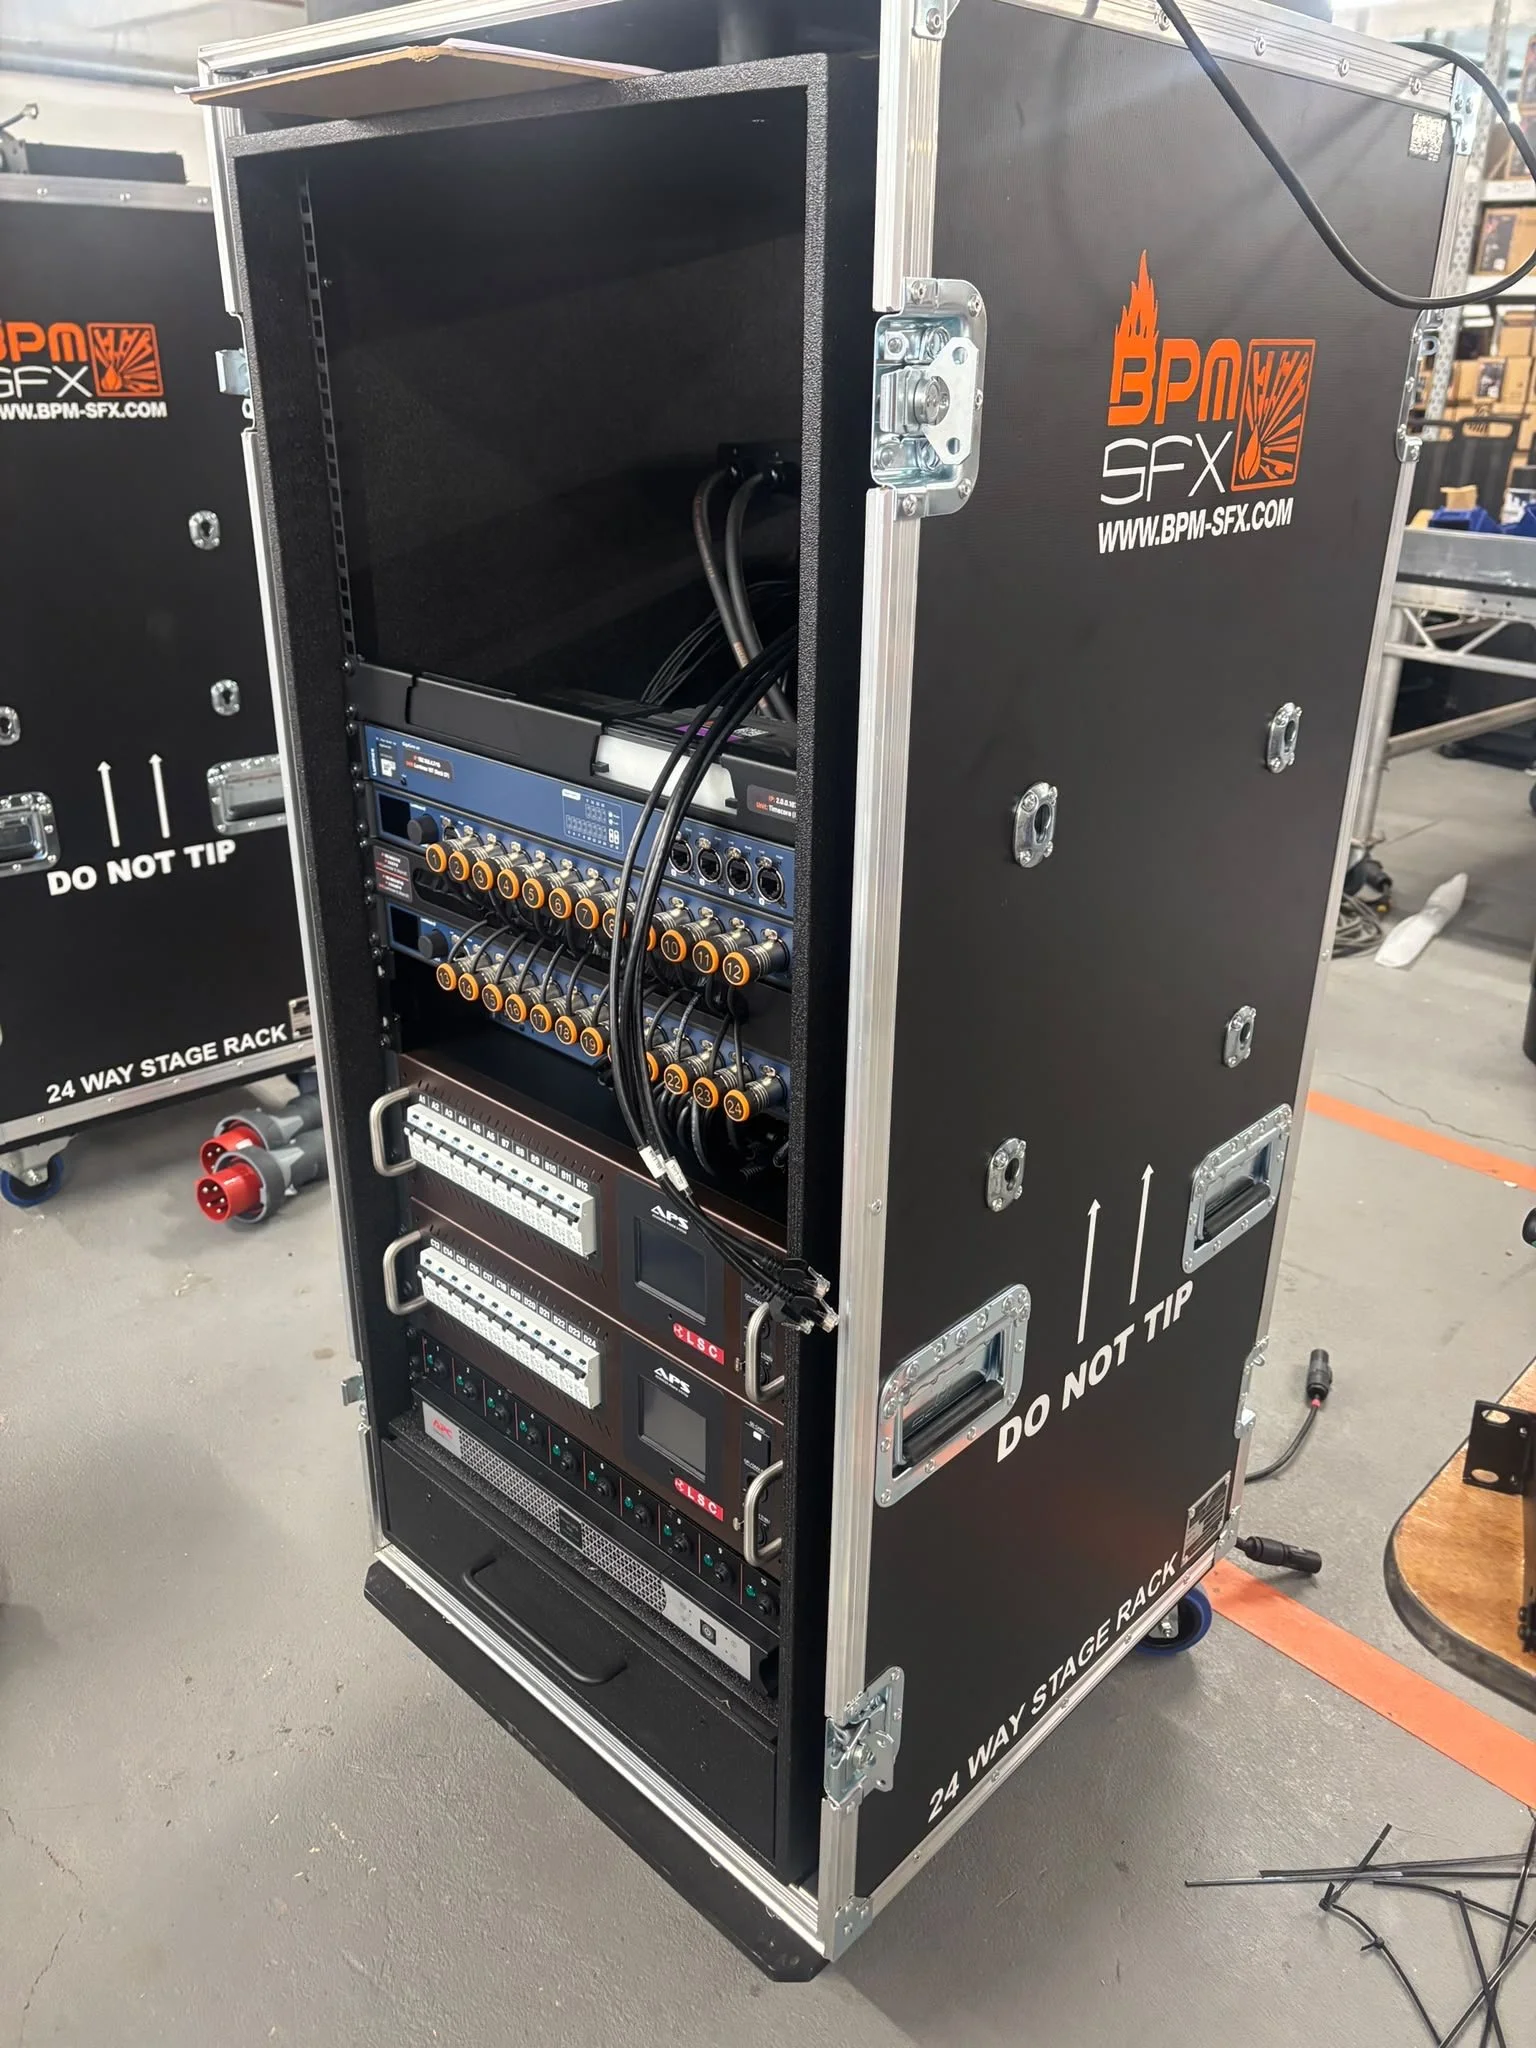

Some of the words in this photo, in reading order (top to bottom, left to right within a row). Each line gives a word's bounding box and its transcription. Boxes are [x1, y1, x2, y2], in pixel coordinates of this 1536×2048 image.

[0, 321, 89, 362] PM
[1107, 336, 1243, 427] BPM
[1100, 430, 1233, 506] SFX
[1098, 497, 1294, 554] WWW.BPM-SFX.COM
[47, 865, 97, 896] DO
[106, 849, 176, 885] NOT
[183, 839, 236, 869] TIP
[454, 862, 461, 874] 2
[477, 870, 484, 883] 3
[503, 878, 510, 892] 4
[528, 888, 535, 901] 5
[554, 899, 562, 911] 6
[581, 907, 588, 921] 7
[665, 940, 678, 956] 10
[699, 951, 710, 967] 11
[439, 971, 449, 984] 13
[727, 964, 741, 980] 12
[461, 982, 472, 995] 14
[485, 991, 496, 1005] 15
[508, 1003, 520, 1016] 16
[533, 1014, 544, 1028] 17
[558, 1026, 570, 1040] 18
[583, 1037, 595, 1051] 19
[46, 1079, 76, 1104] 24
[80, 1063, 134, 1094] WAY
[140, 1042, 219, 1077] STAGE
[223, 1023, 287, 1056] RACK
[667, 1073, 681, 1089] 22
[697, 1086, 711, 1103] 23
[727, 1100, 742, 1115] 24
[650, 1205, 689, 1230] APS
[686, 1330, 718, 1359] LSC
[997, 1393, 1050, 1463] DO
[1062, 1323, 1135, 1411] NOT
[1144, 1280, 1194, 1343] TIP
[654, 1367, 691, 1394] APS
[687, 1485, 718, 1515] LSC
[928, 1770, 960, 1824] 24
[967, 1703, 1026, 1779] WAY
[1031, 1619, 1111, 1715] STAGE
[1115, 1552, 1178, 1631] RACK
